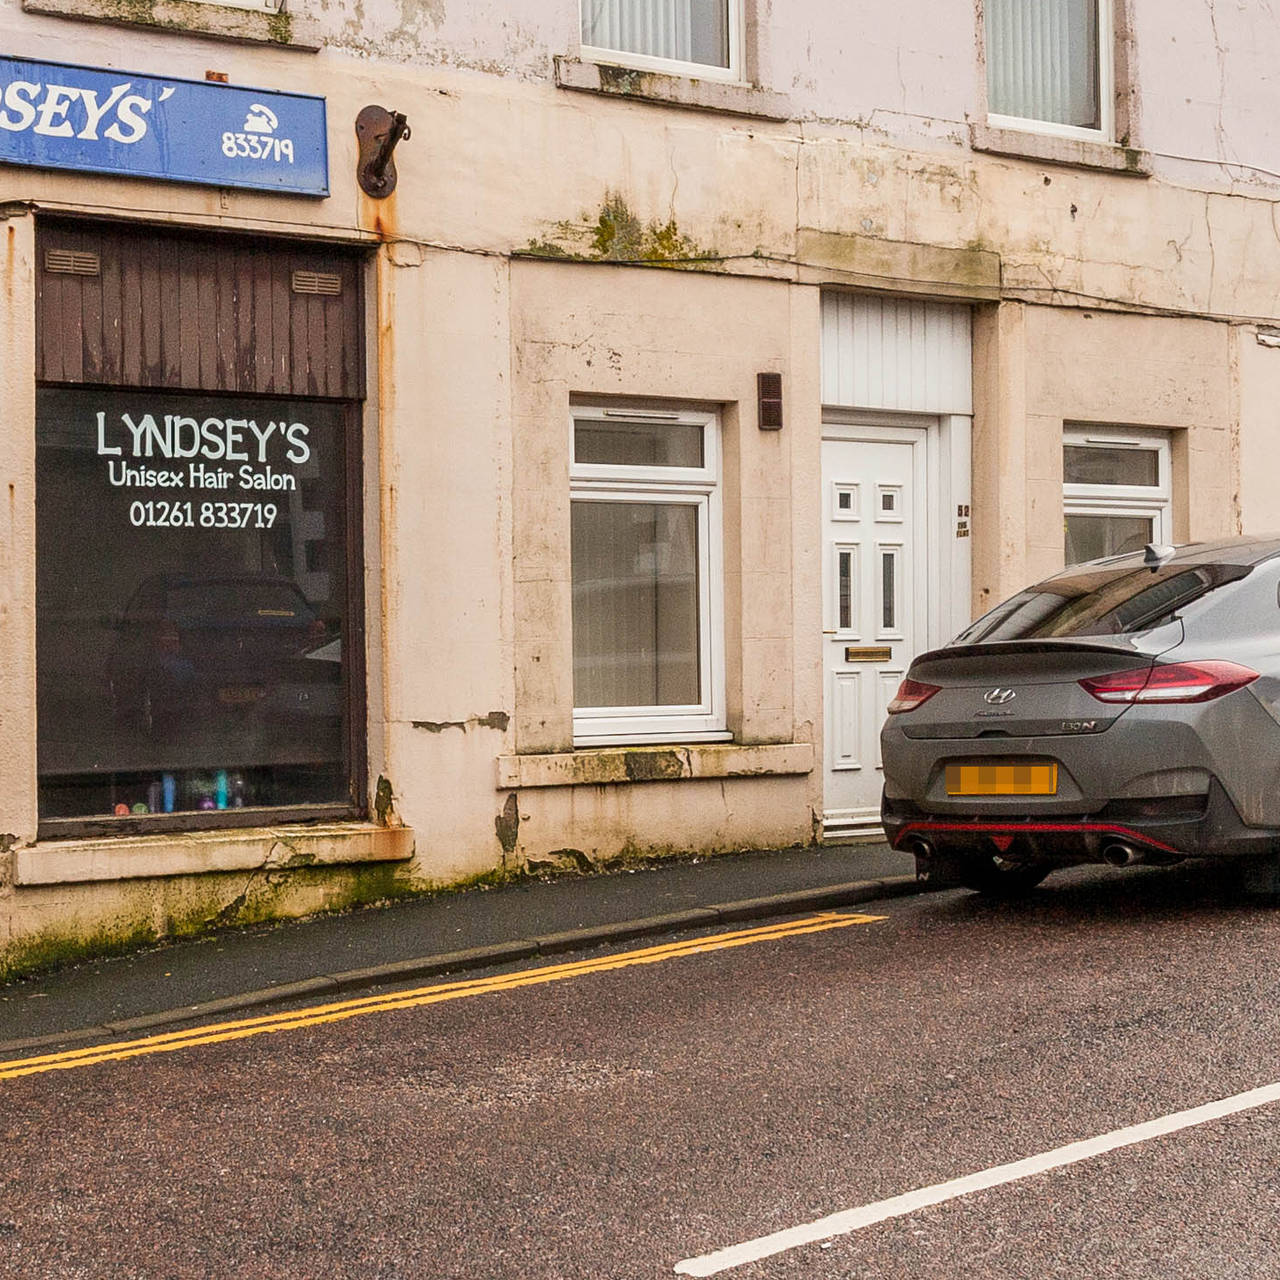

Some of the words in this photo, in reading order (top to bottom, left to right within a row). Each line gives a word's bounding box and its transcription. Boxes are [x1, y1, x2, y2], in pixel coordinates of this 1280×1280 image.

[221, 131, 295, 165] 833719
[96, 411, 311, 464] LYNDSEY'S
[108, 460, 184, 488] Unisex
[189, 463, 234, 489] Hair
[238, 465, 297, 491] Salon
[129, 500, 193, 527] 01261
[199, 502, 278, 529] 833719
